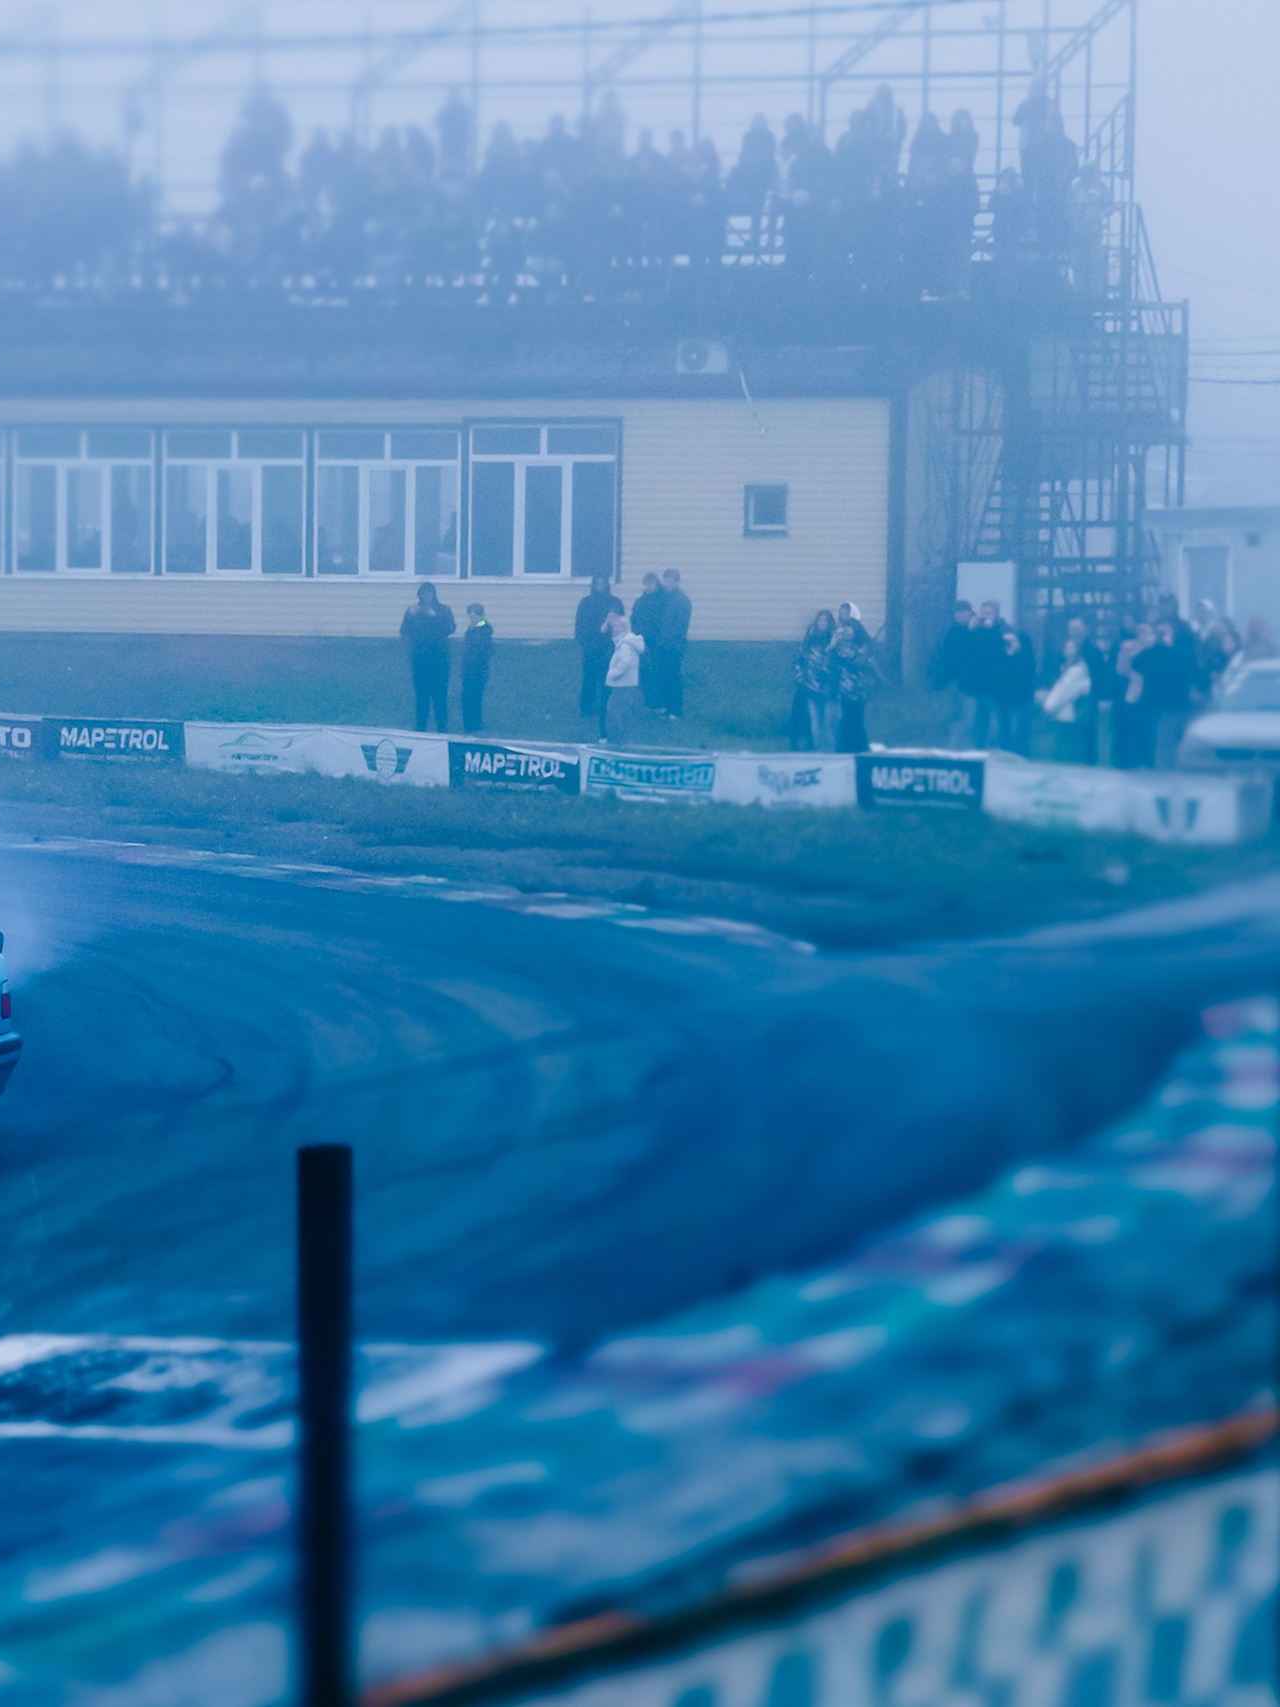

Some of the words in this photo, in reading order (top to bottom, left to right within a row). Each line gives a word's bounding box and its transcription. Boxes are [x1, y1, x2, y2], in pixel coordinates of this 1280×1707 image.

[60, 726, 170, 751] MAPETROL
[464, 751, 566, 778] MAPETROL
[871, 765, 975, 796] MAPETROL
